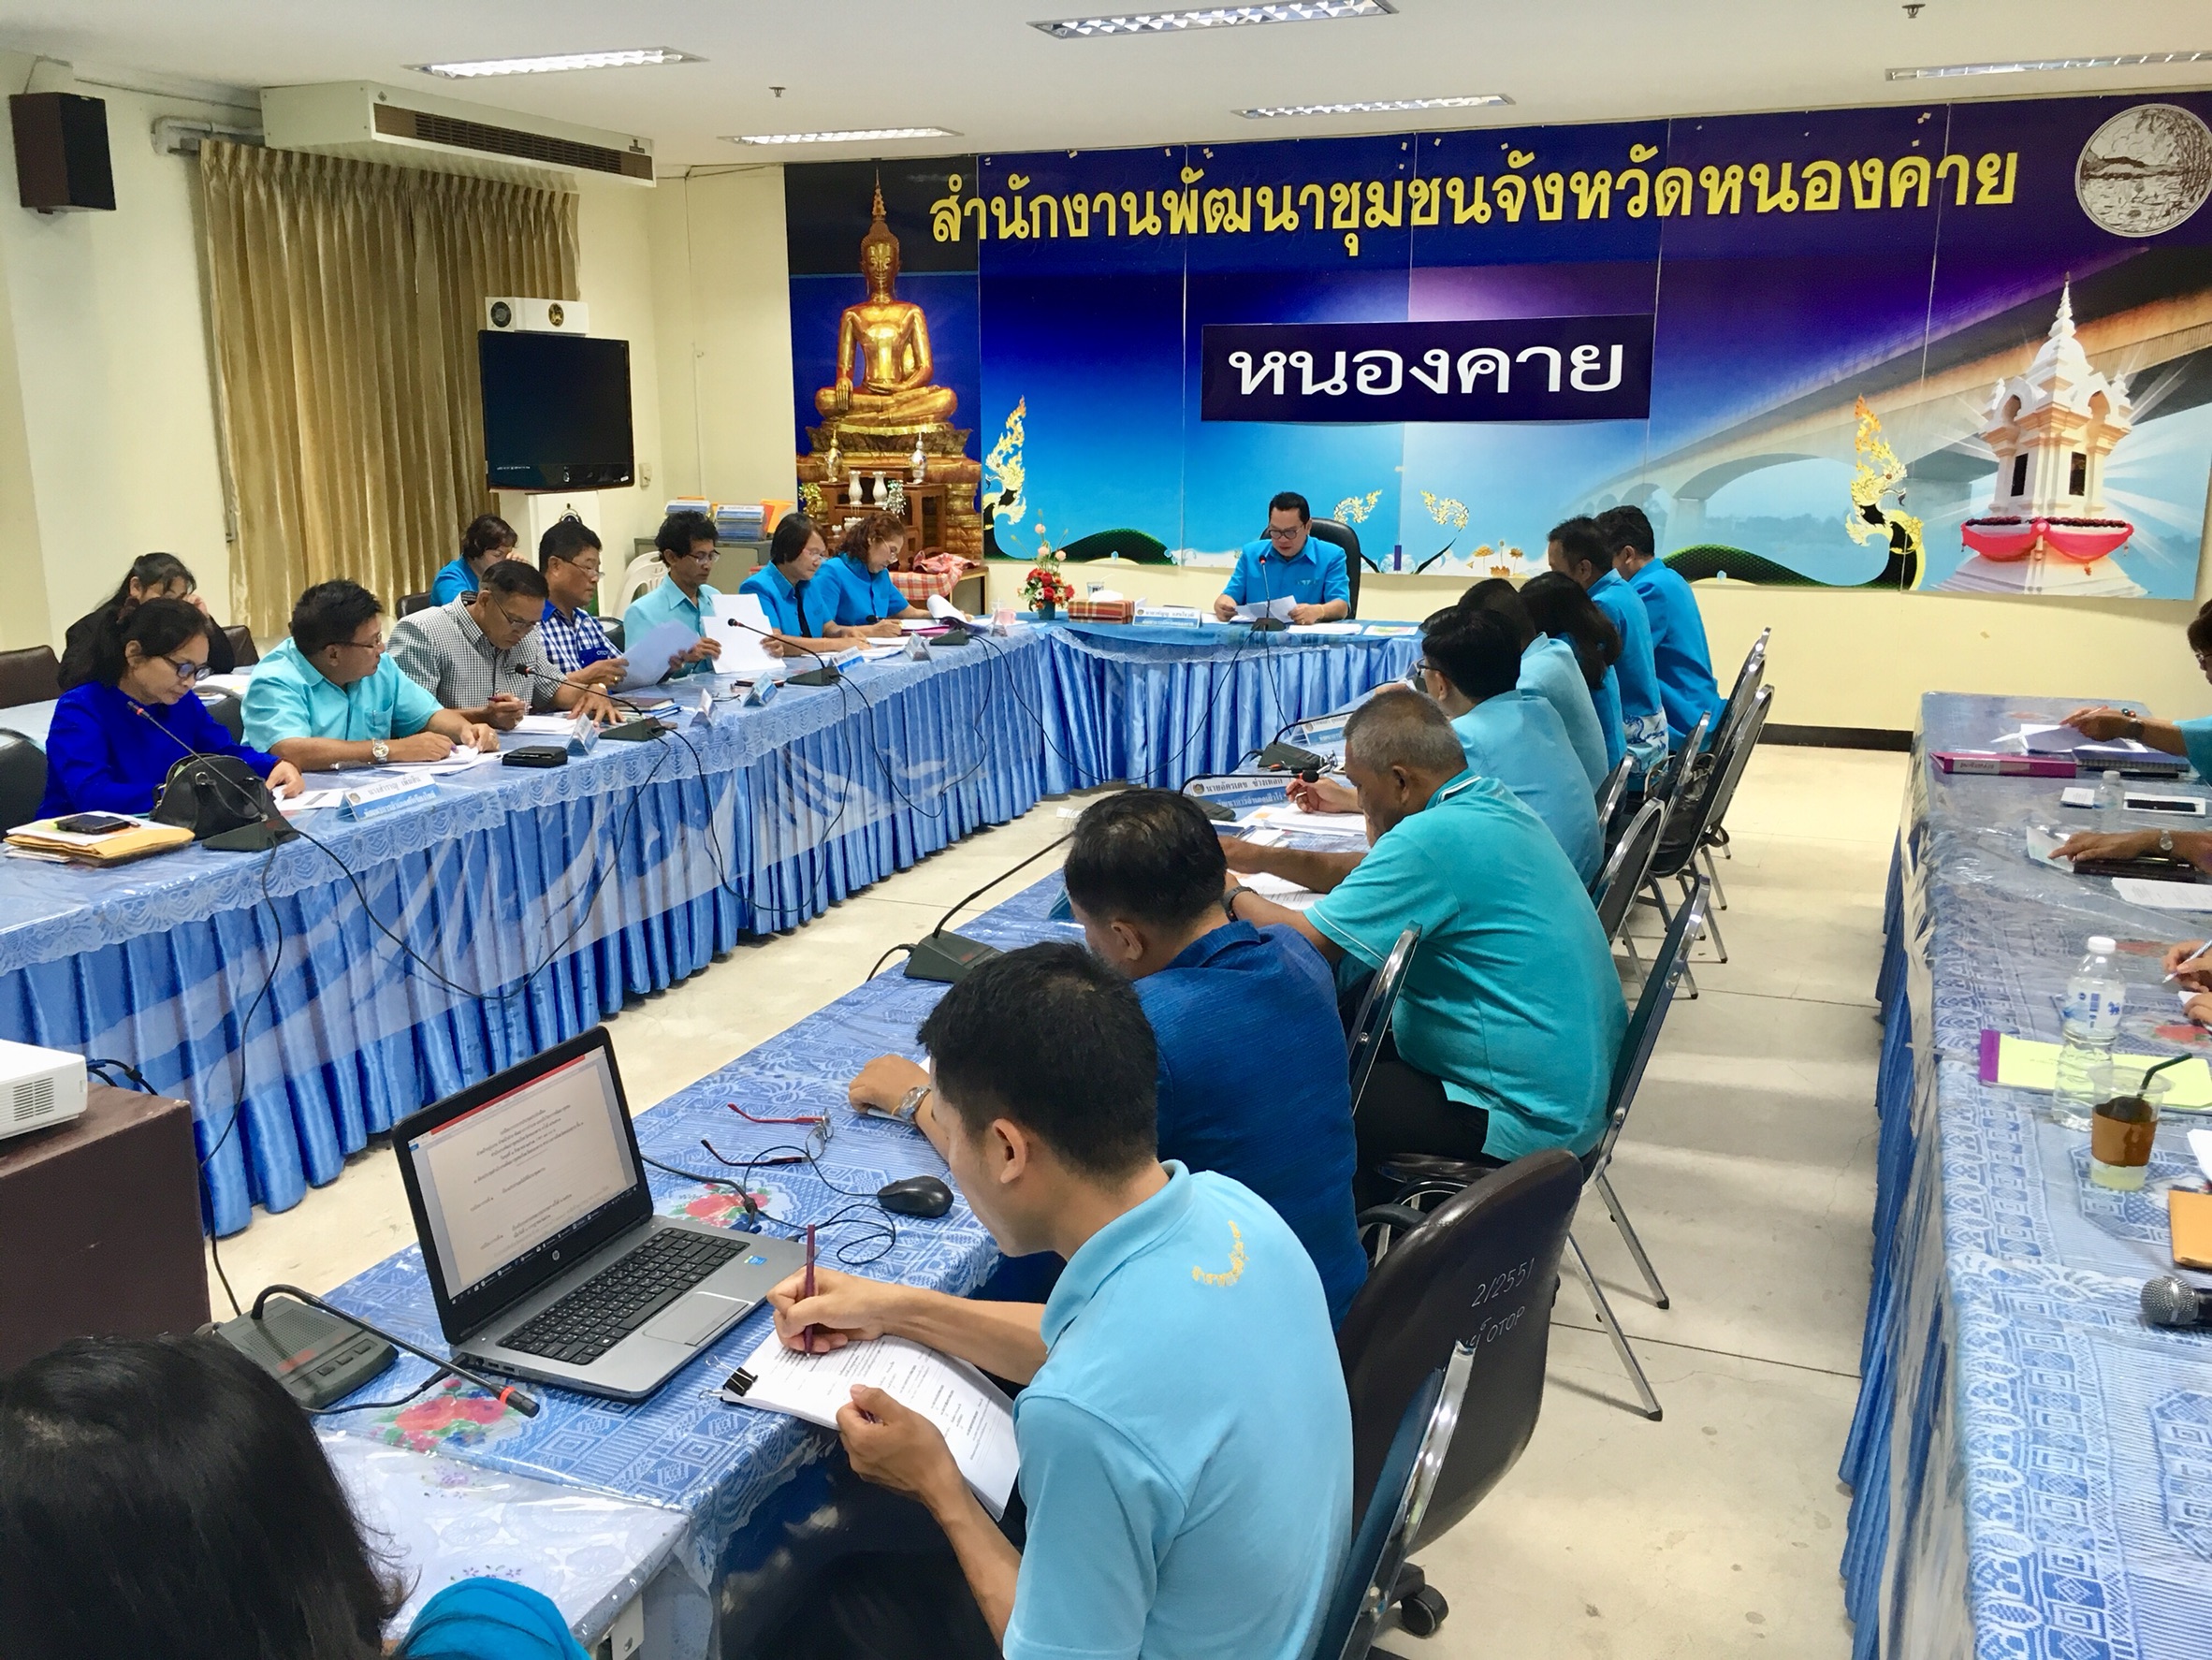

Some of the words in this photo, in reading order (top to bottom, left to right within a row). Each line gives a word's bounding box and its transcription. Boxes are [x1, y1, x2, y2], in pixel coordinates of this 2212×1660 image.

[929, 143, 2018, 256] สำนักงานพัฒนาชุมชนจังหวัดหนองคาย
[1229, 344, 1623, 396] หนองคาย
[1471, 1257, 1535, 1307] 2/2551
[1486, 1305, 1526, 1343] OTOP
